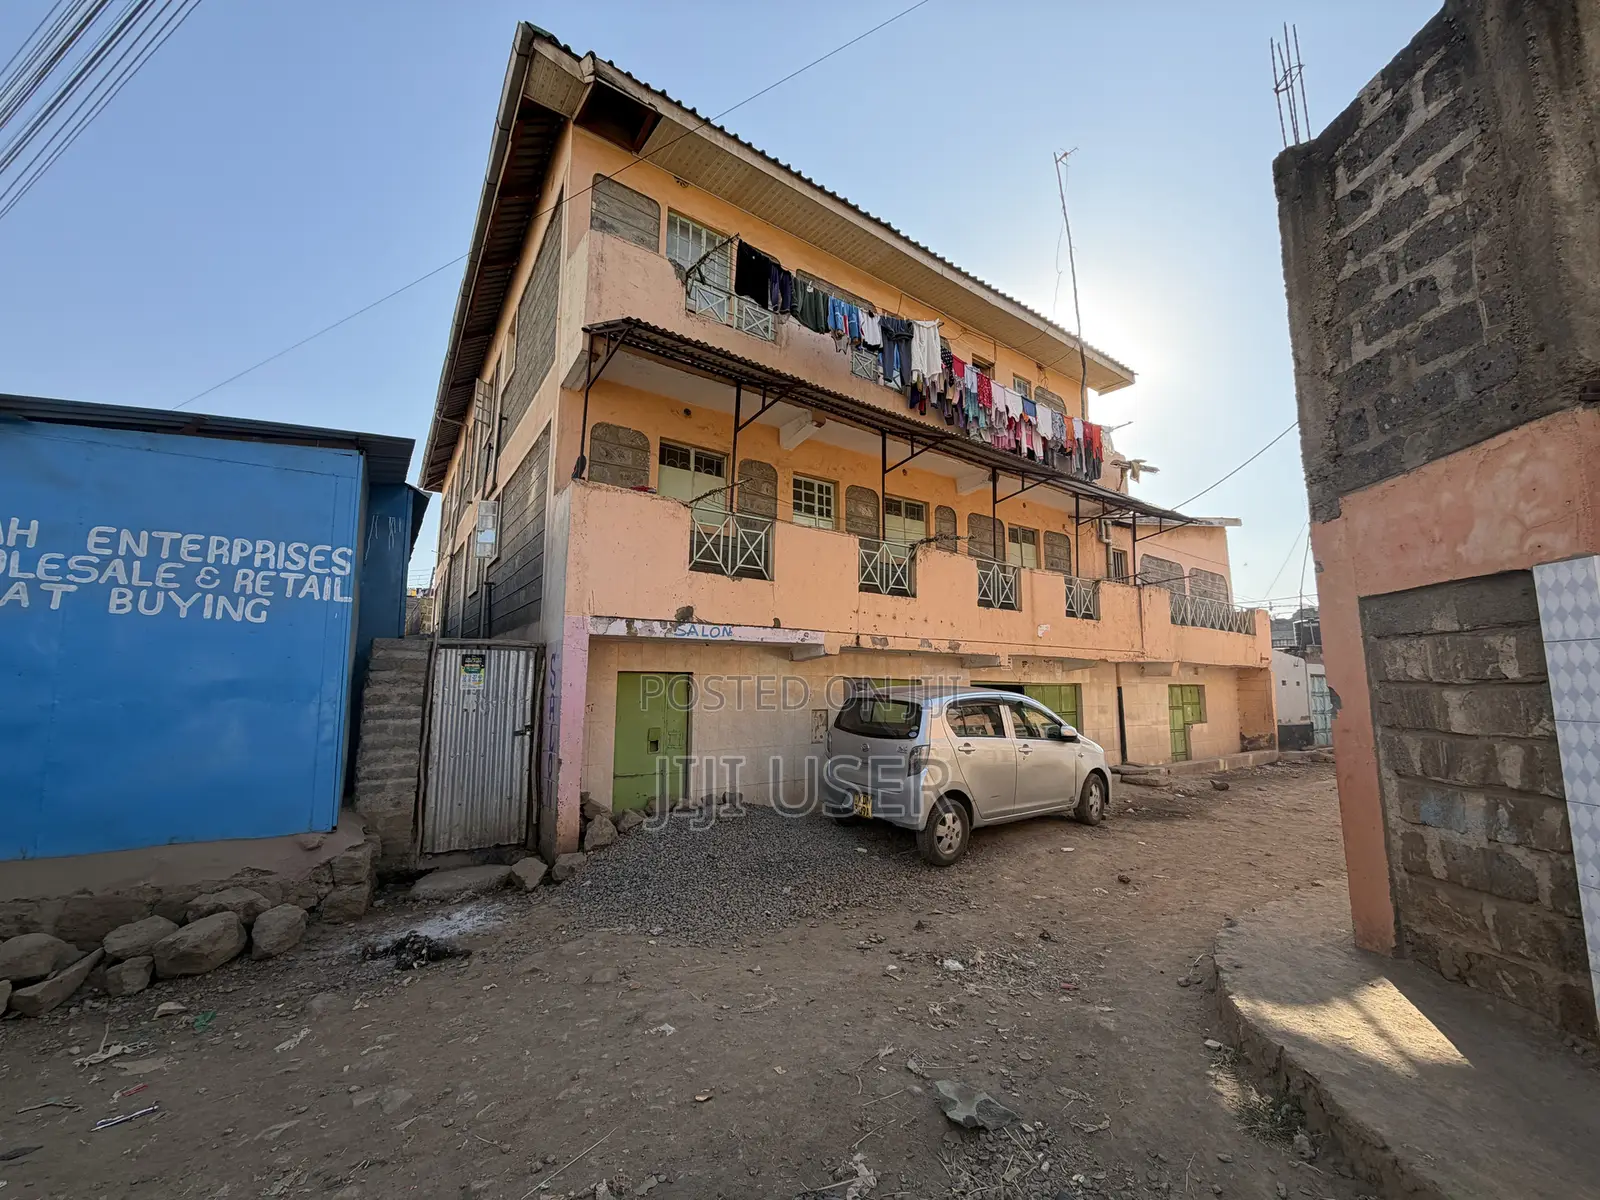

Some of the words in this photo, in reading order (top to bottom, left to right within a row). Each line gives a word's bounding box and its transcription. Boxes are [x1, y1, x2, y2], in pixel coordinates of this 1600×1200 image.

[0, 517, 39, 548] H
[86, 526, 353, 576] ENTERPRISES
[195, 566, 221, 589] &
[233, 568, 353, 603] RETAIL
[108, 586, 271, 623] BUYING
[674, 624, 733, 639] SALON
